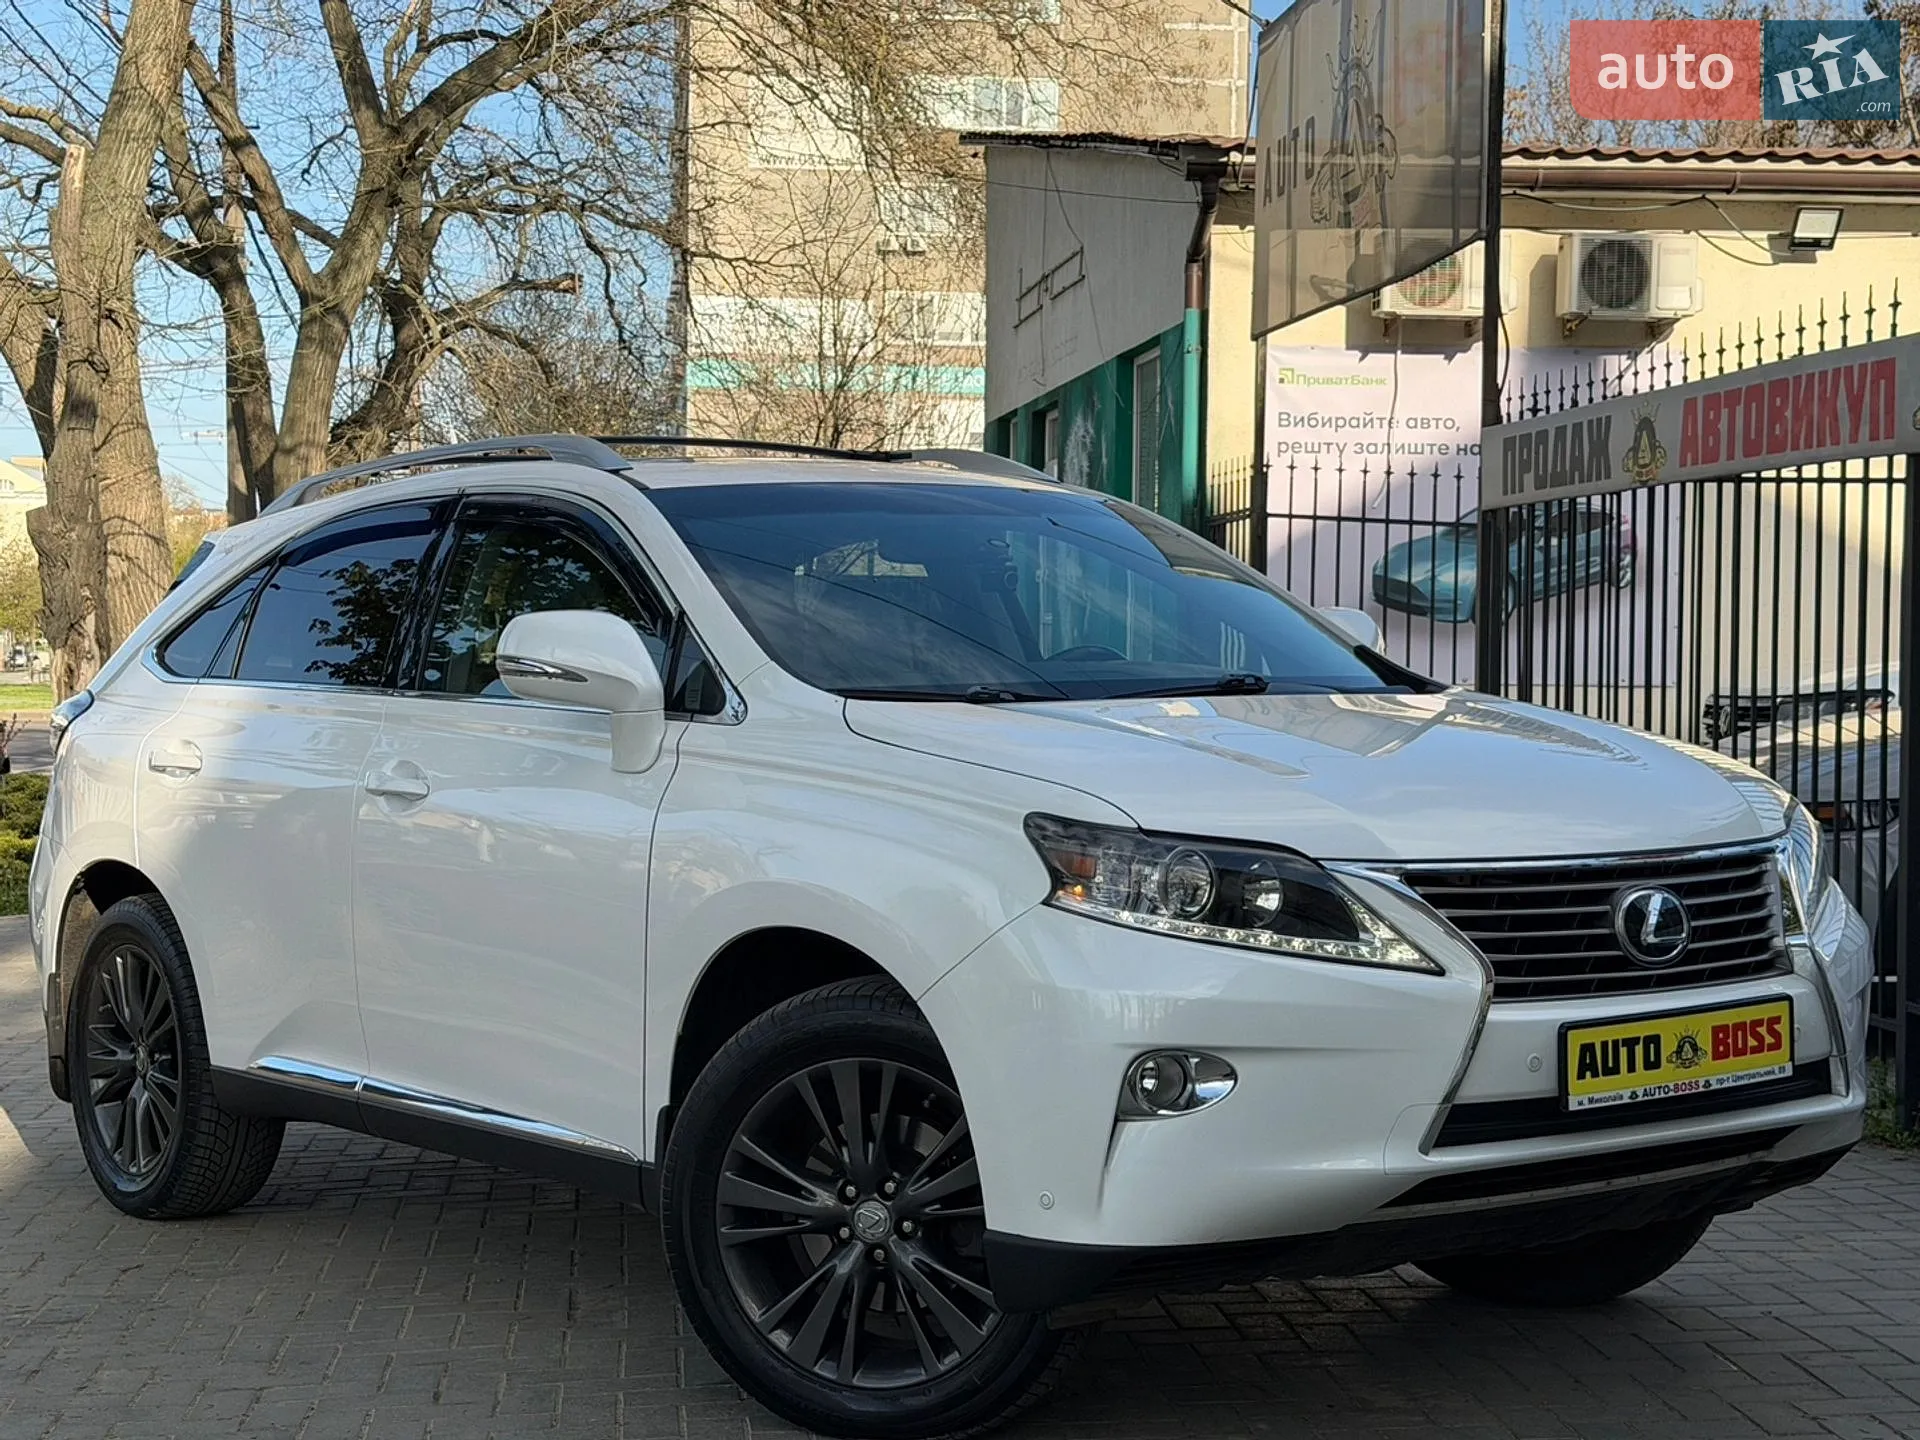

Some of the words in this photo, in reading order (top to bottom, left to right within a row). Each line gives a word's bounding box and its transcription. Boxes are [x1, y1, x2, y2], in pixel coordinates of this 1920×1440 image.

[1263, 116, 1315, 208] AUTO
[1295, 373, 1389, 387] ПриватБанк
[1406, 416, 1461, 432] авто,
[1502, 414, 1613, 497] ПРОДАЖ
[1679, 357, 1897, 468] АВТОВИКУП
[1277, 441, 1347, 458] решту
[1353, 442, 1449, 456] залиште
[1576, 1033, 1662, 1081] AUTO
[1711, 1015, 1783, 1061] BOSS
[1641, 1081, 1701, 1099] AUTO-BOSS
